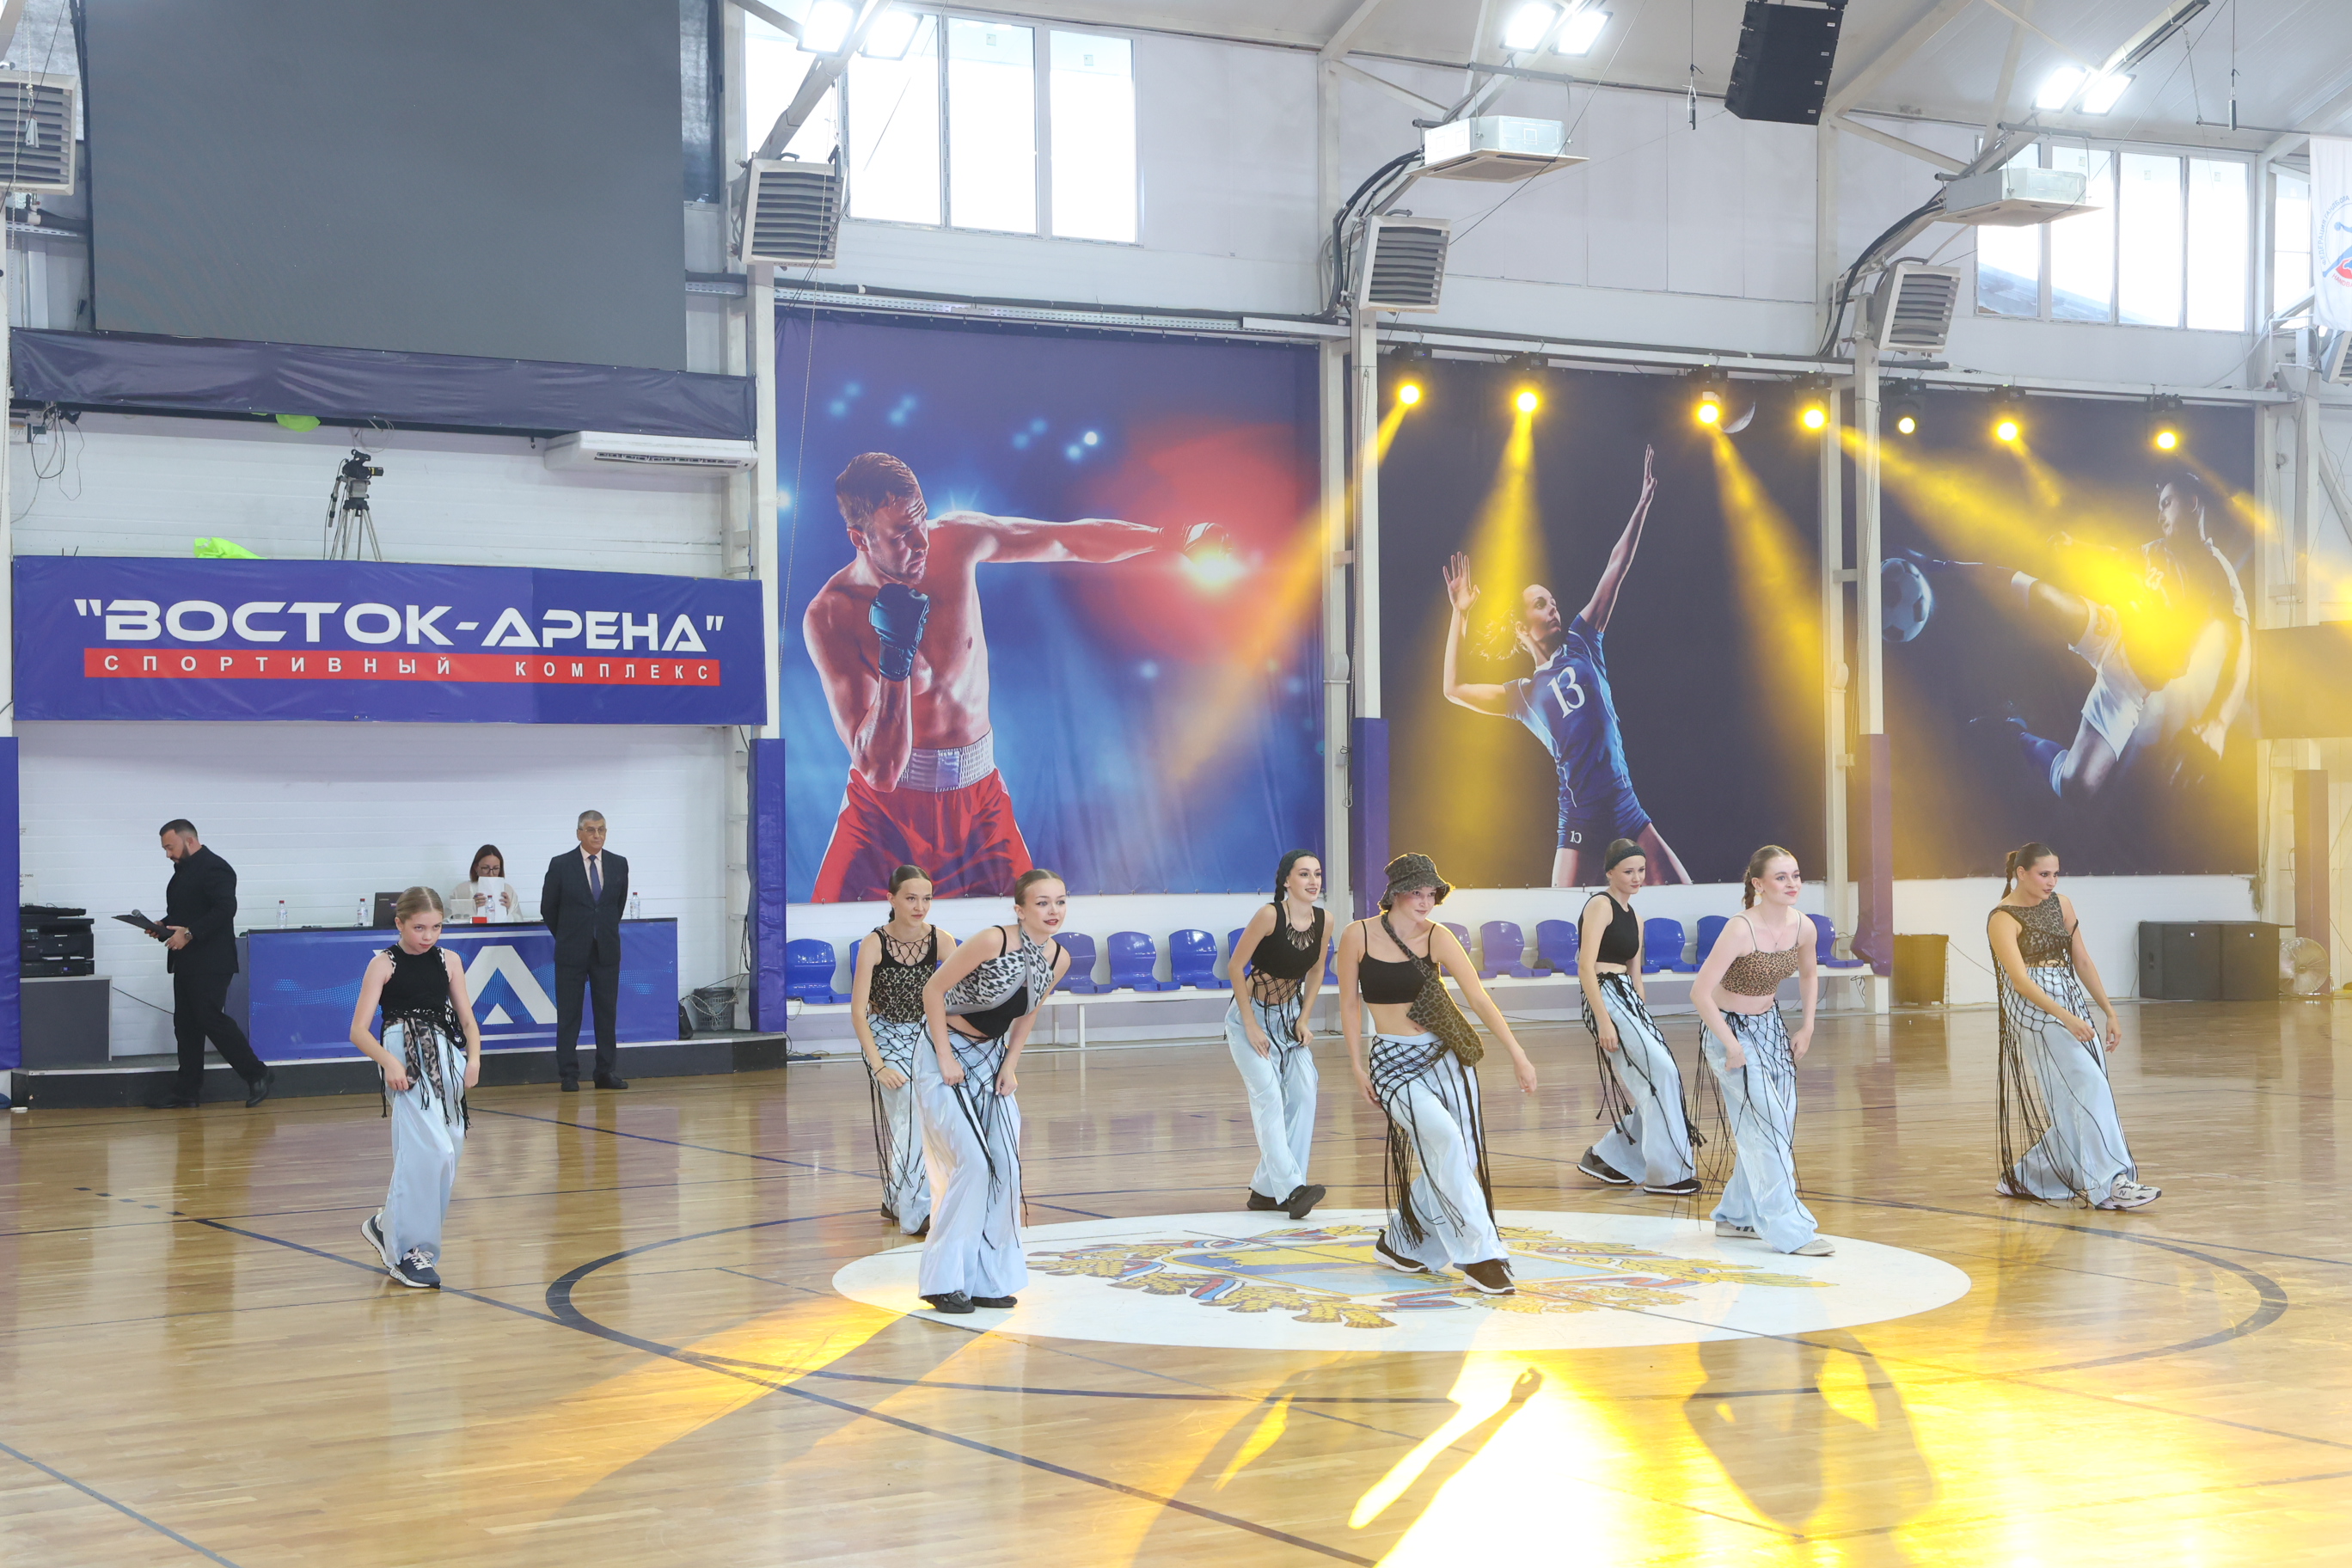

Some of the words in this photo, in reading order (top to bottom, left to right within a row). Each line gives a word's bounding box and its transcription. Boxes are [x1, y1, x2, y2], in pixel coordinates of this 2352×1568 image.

[2318, 219, 2326, 266] ФЕДЕРАЦИЯ
[2324, 195, 2350, 219] ГАНДБОЛА
[2145, 567, 2165, 591] 23
[104, 655, 450, 676] СПОРТИВНЫЙ
[515, 661, 707, 680] КОМПЛЕКС
[1547, 665, 1586, 720] 13
